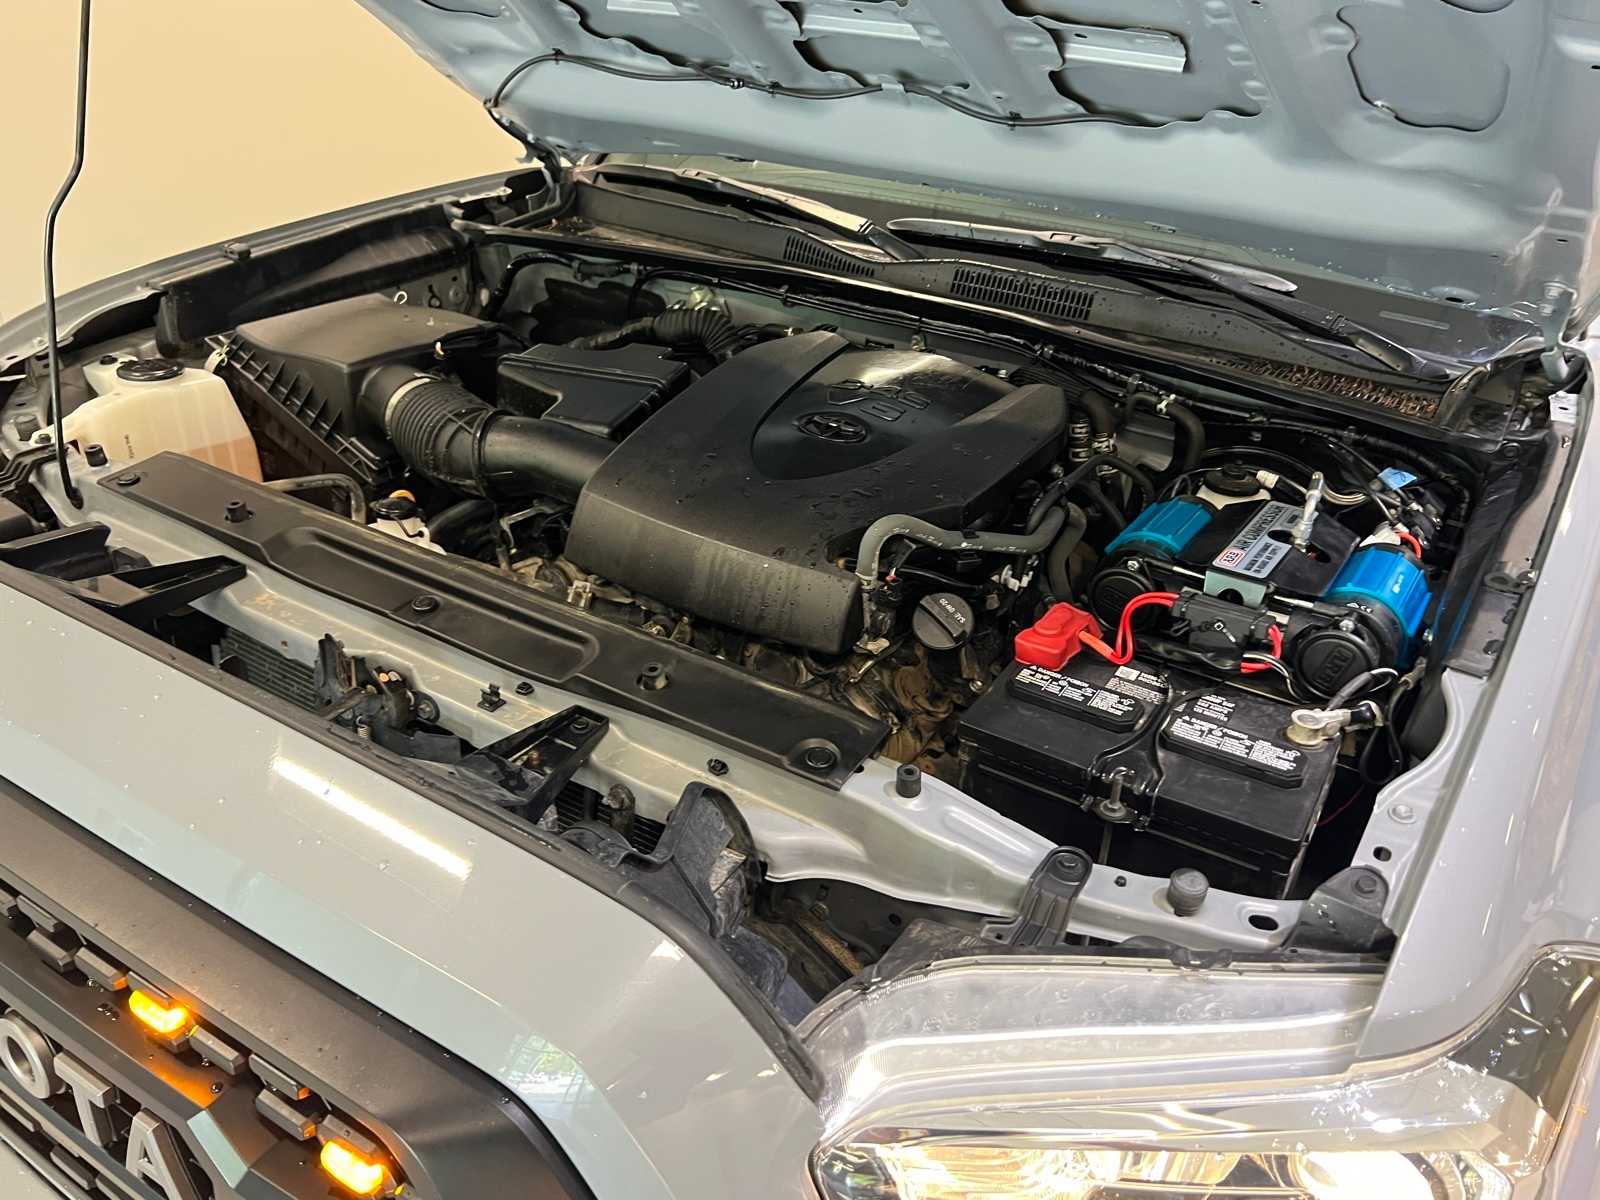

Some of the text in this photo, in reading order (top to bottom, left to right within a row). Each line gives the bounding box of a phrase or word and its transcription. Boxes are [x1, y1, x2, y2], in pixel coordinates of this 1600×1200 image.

[1232, 503, 1285, 551] AIR COMPRESSOR
[1066, 675, 1090, 688] POISON
[1222, 728, 1249, 740] POISON
